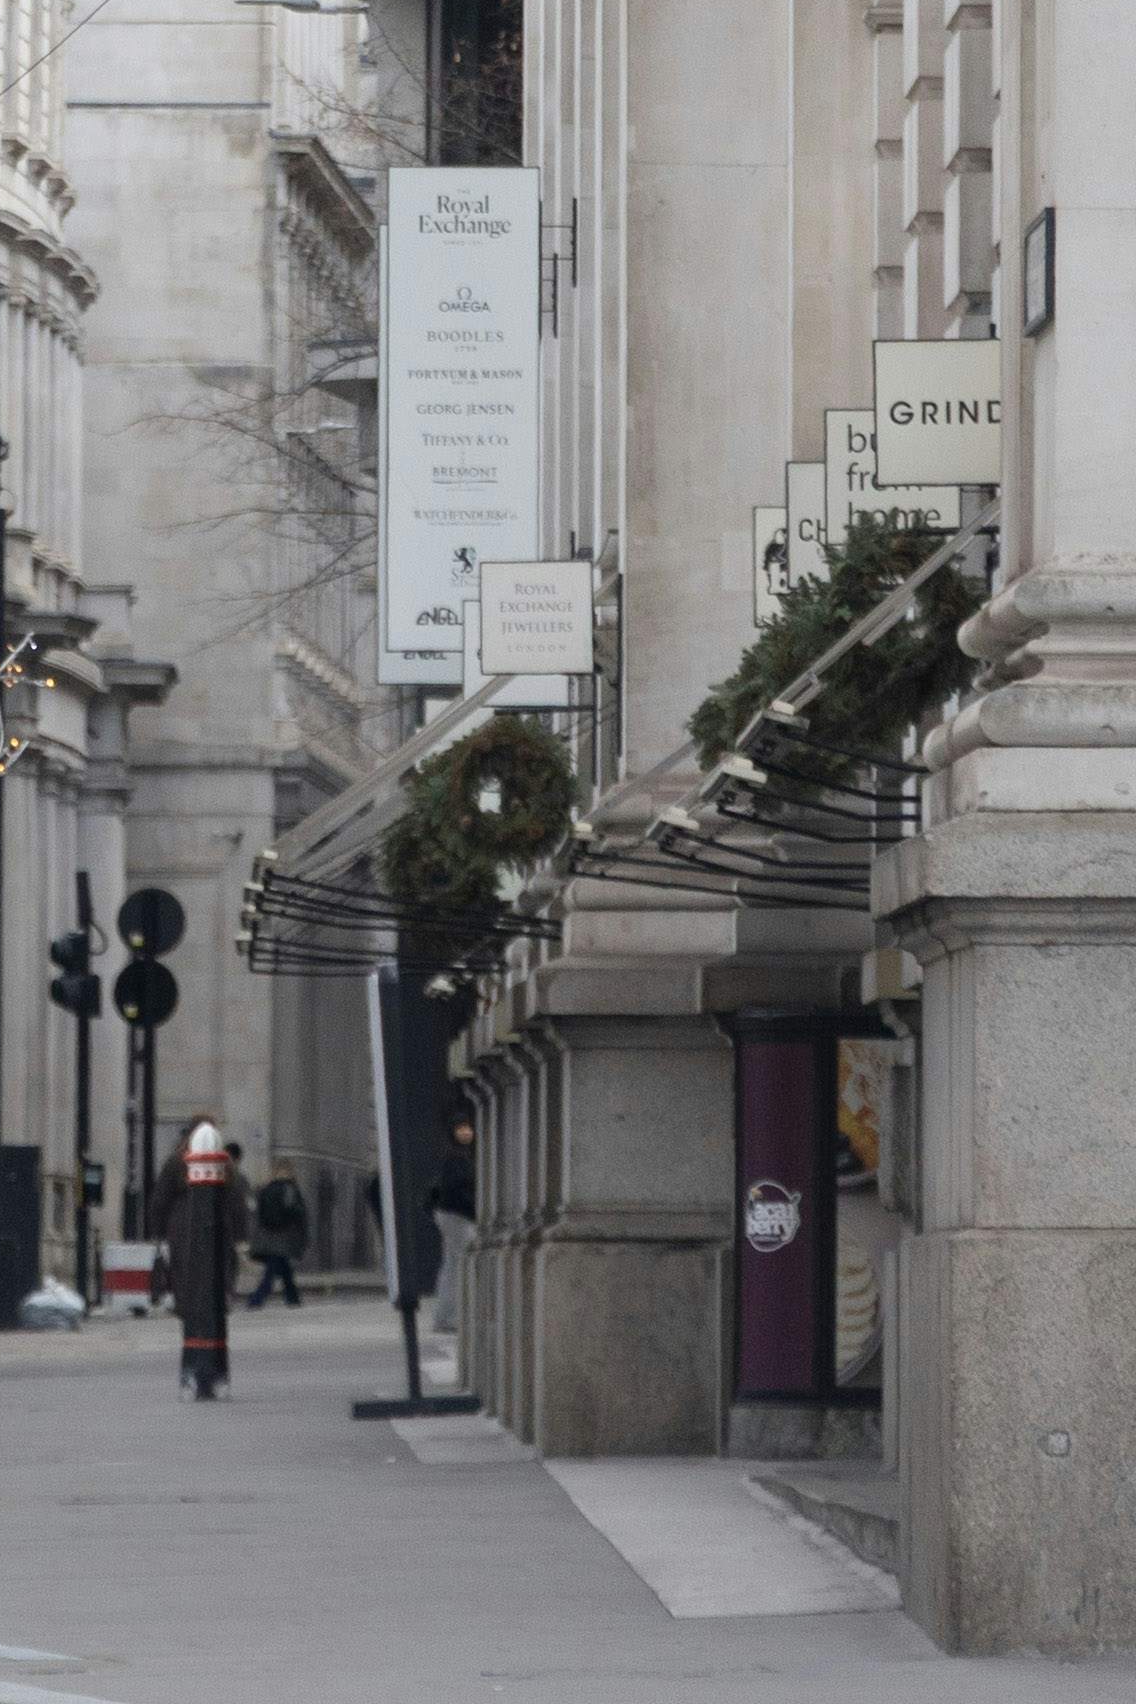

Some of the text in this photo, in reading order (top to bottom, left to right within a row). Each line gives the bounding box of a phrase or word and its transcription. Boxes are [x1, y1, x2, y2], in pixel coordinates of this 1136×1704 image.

[437, 195, 490, 218] Royal
[419, 215, 512, 239] Exchange
[438, 301, 491, 313] OMEGA
[427, 330, 504, 343] BOODLES
[408, 369, 468, 380] FORTNUM
[482, 369, 524, 380] MASON
[416, 403, 515, 416] GEORG JENSEN
[433, 467, 498, 477] BREMONT
[515, 583, 558, 596] ROYAL
[500, 601, 575, 613] EXCHANGE
[501, 621, 573, 635] JEWELLERS
